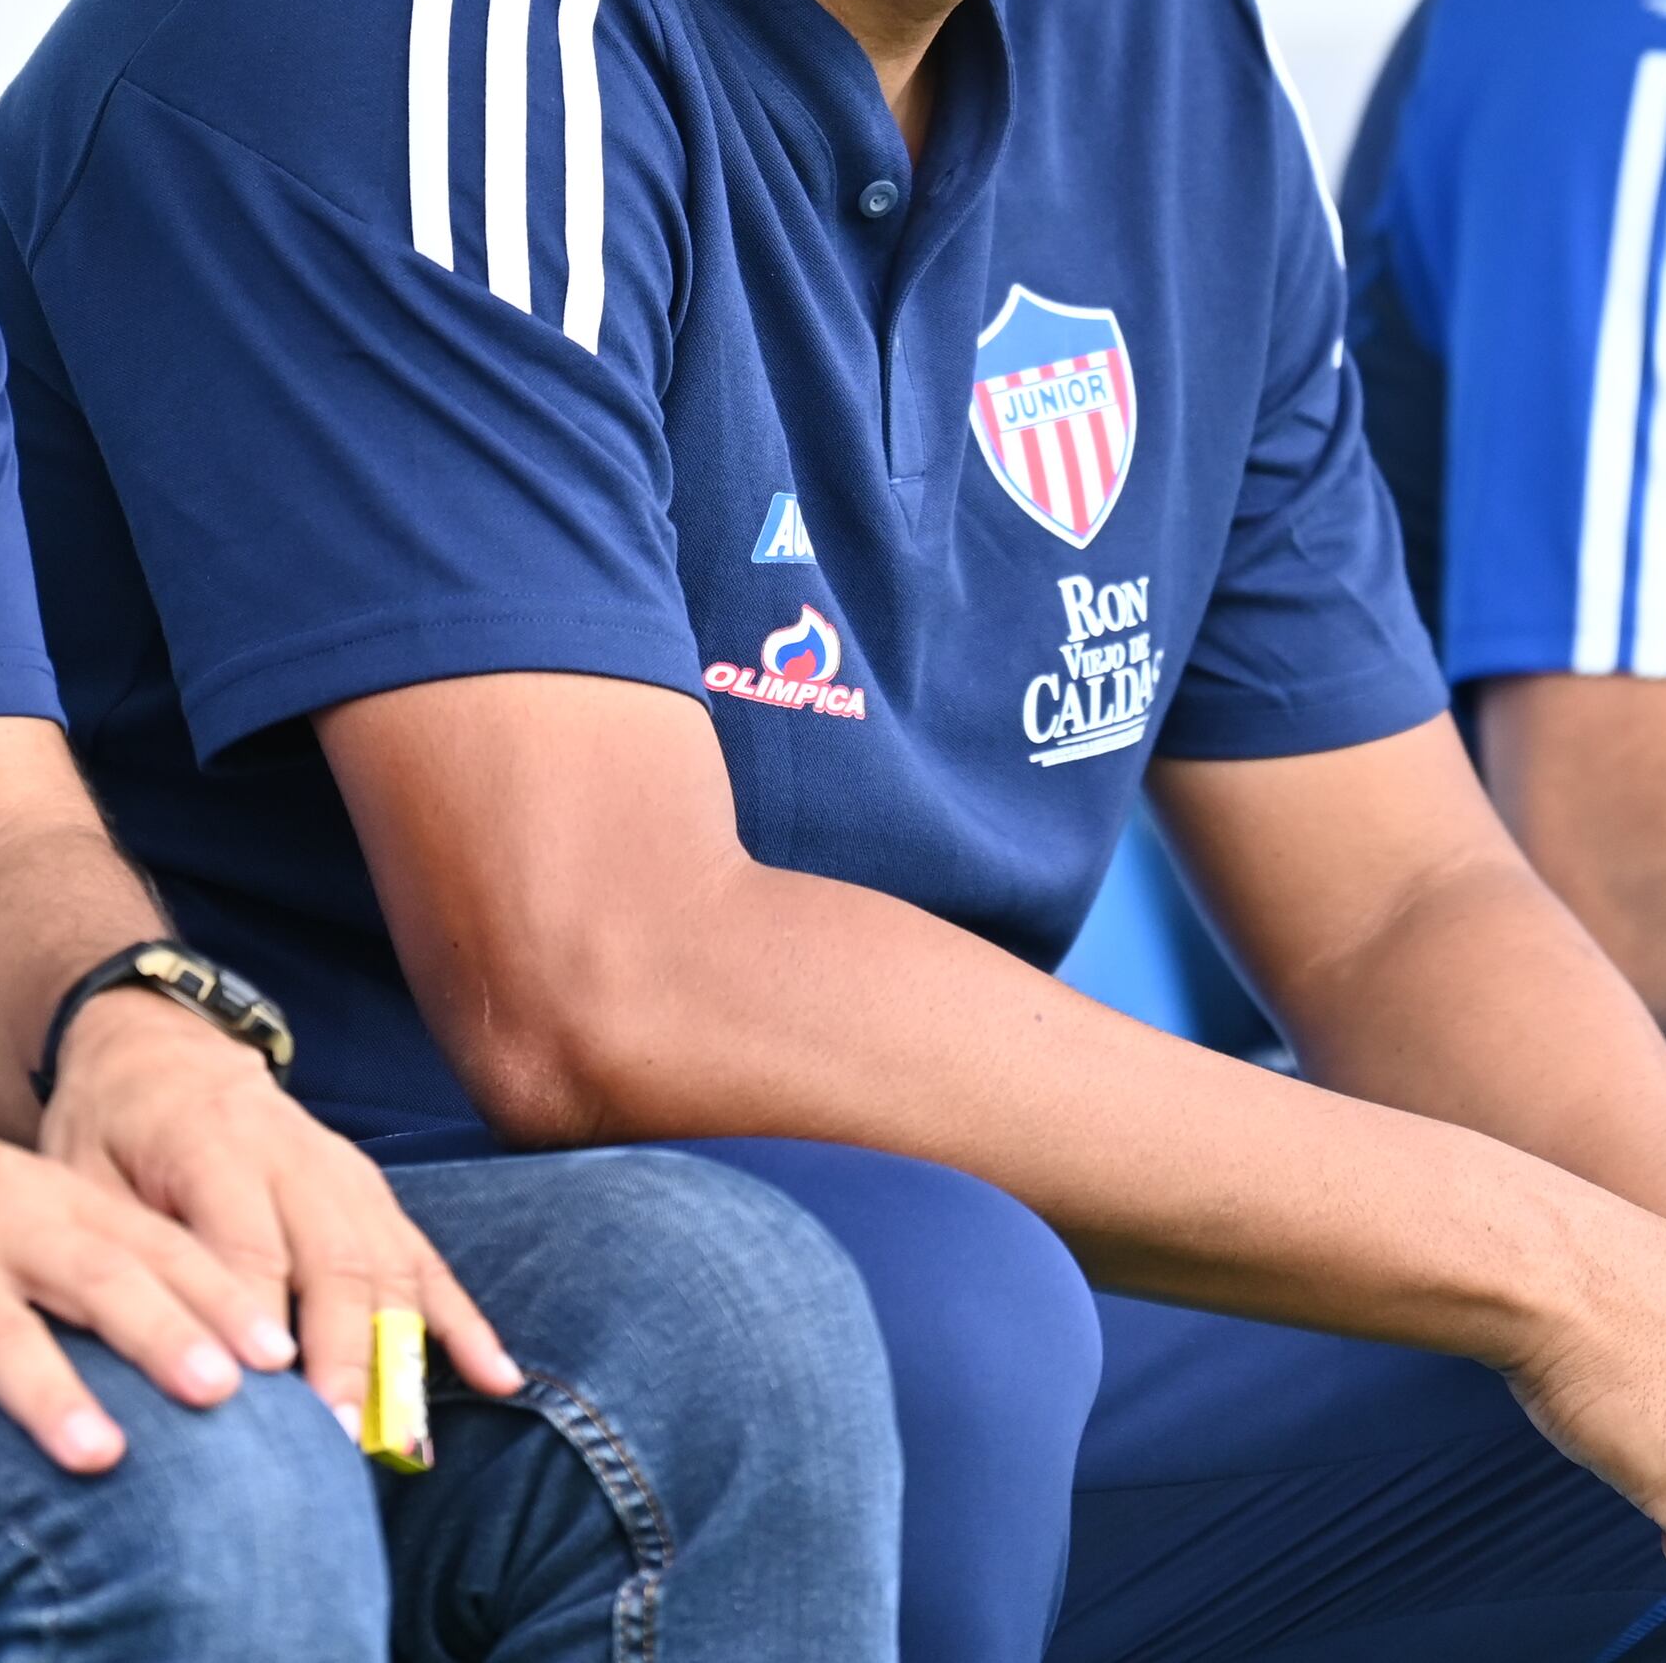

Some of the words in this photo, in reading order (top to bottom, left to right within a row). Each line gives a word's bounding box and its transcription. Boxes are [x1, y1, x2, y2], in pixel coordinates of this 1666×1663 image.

[1004, 374, 1107, 423] JUNIOR
[1057, 574, 1150, 643] RON
[703, 662, 866, 719] OLIMPICA
